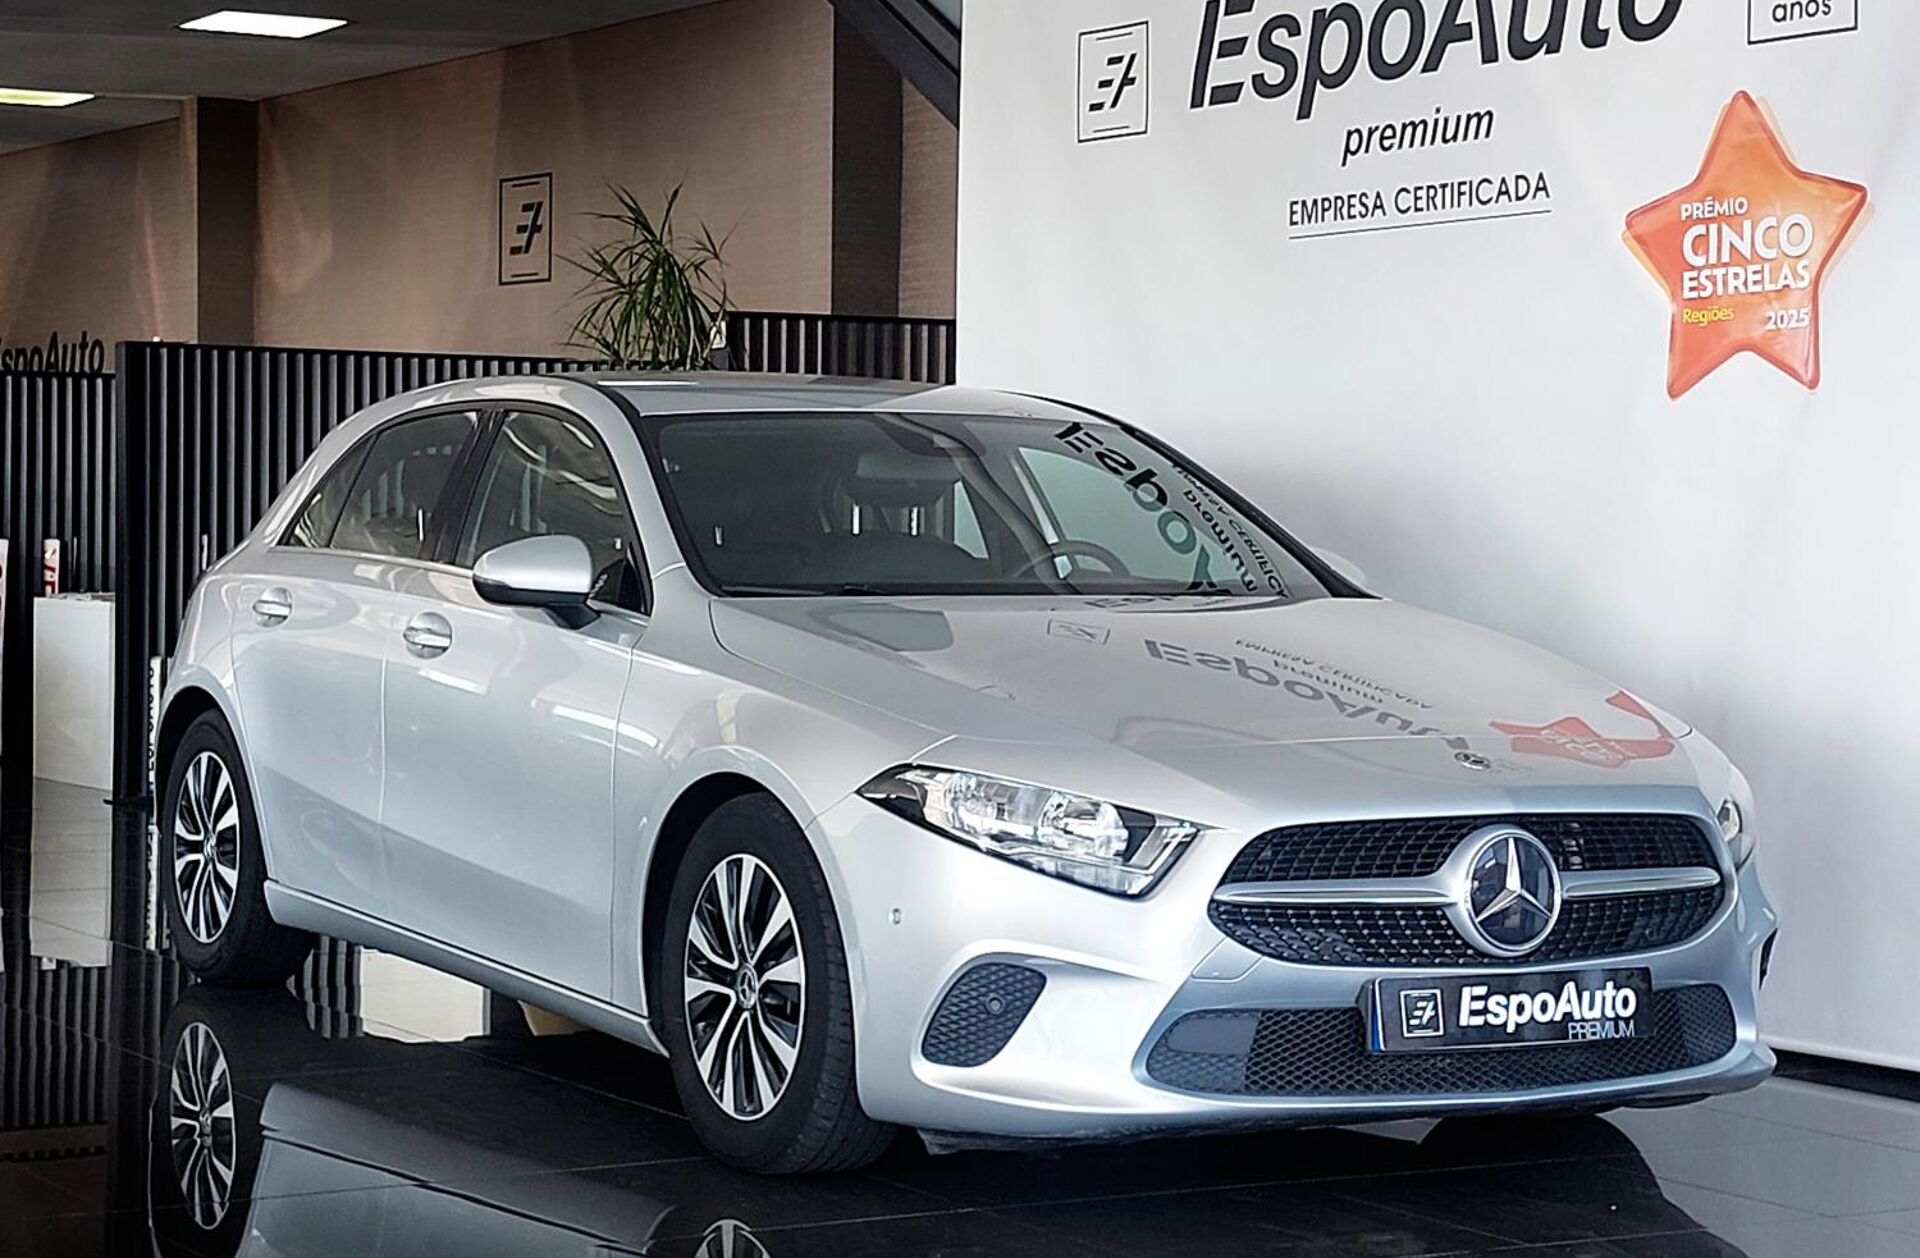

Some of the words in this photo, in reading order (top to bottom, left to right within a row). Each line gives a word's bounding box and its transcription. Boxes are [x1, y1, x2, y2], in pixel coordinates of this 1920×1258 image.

[1772, 0, 1831, 22] anos
[1341, 106, 1493, 167] premium
[1289, 191, 1386, 226] EMPRESA
[1394, 172, 1550, 214] CERTIFICADA
[1681, 196, 1748, 221] PRÉMIO
[1682, 213, 1813, 267] CINCO
[1682, 259, 1811, 299] ESTRELAS
[1682, 305, 1734, 326] Regiões
[1765, 307, 1809, 330] 2025
[0, 331, 104, 373] spoAuto
[1458, 980, 1637, 1033] EspoAuto
[1568, 1020, 1635, 1041] PREMIUM
